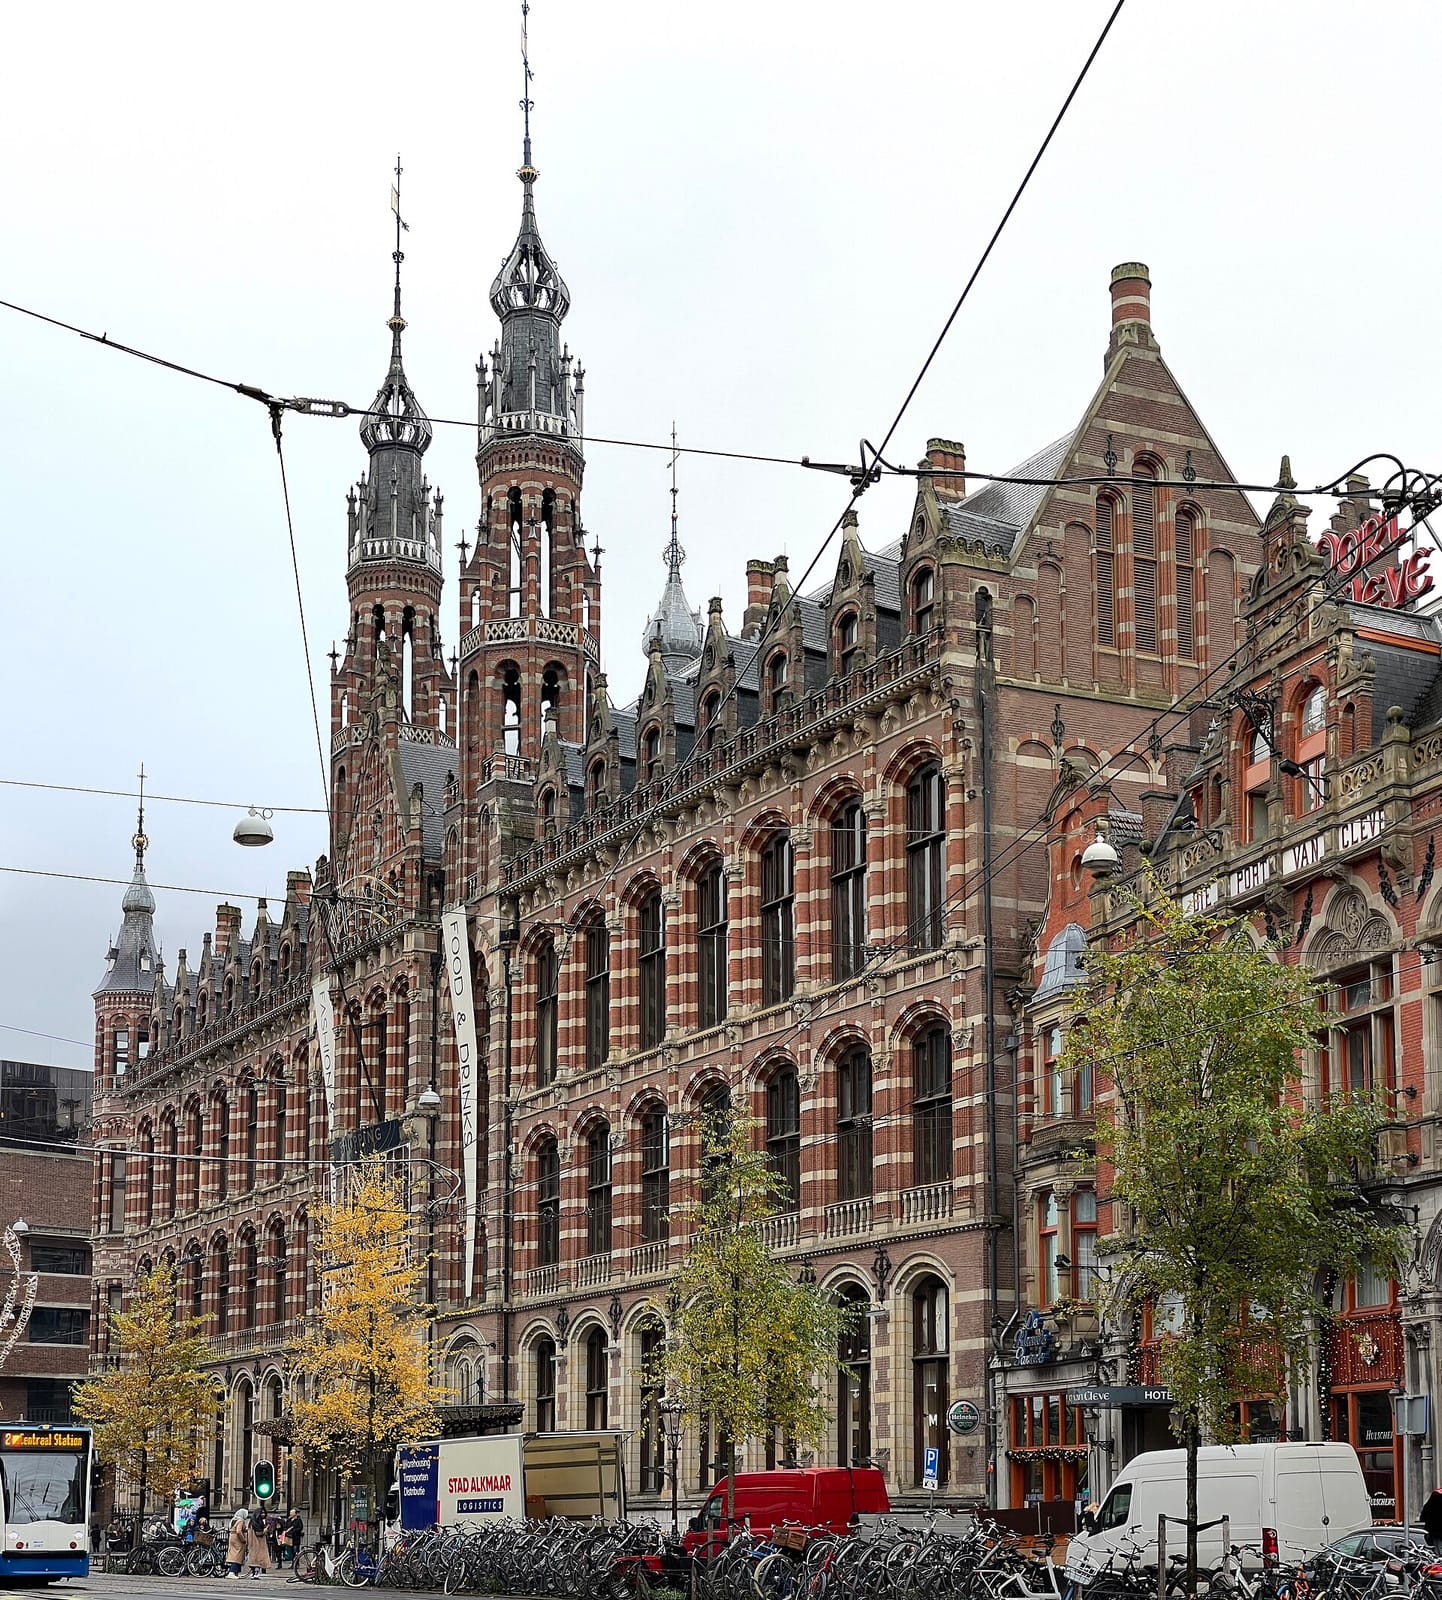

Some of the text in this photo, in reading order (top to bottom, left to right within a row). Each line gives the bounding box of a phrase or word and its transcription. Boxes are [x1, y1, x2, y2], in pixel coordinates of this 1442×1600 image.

[1192, 885, 1211, 912] DIE
[1236, 858, 1270, 895] PORT
[1292, 838, 1319, 871] VAN
[319, 991, 333, 1088] FASHION
[449, 920, 473, 1148] FOOD & DRINKS
[338, 1127, 382, 1155] SHOPPING
[1144, 1391, 1178, 1400] HOTE
[5, 1433, 83, 1446] 2 Centraal Station
[402, 1458, 431, 1469] Warehousing
[927, 1450, 935, 1466] P
[403, 1473, 429, 1484] Transporten
[448, 1474, 512, 1494] STAD ALKMAAR
[403, 1486, 426, 1497] Distributie
[458, 1501, 503, 1511] LOGISTICS
